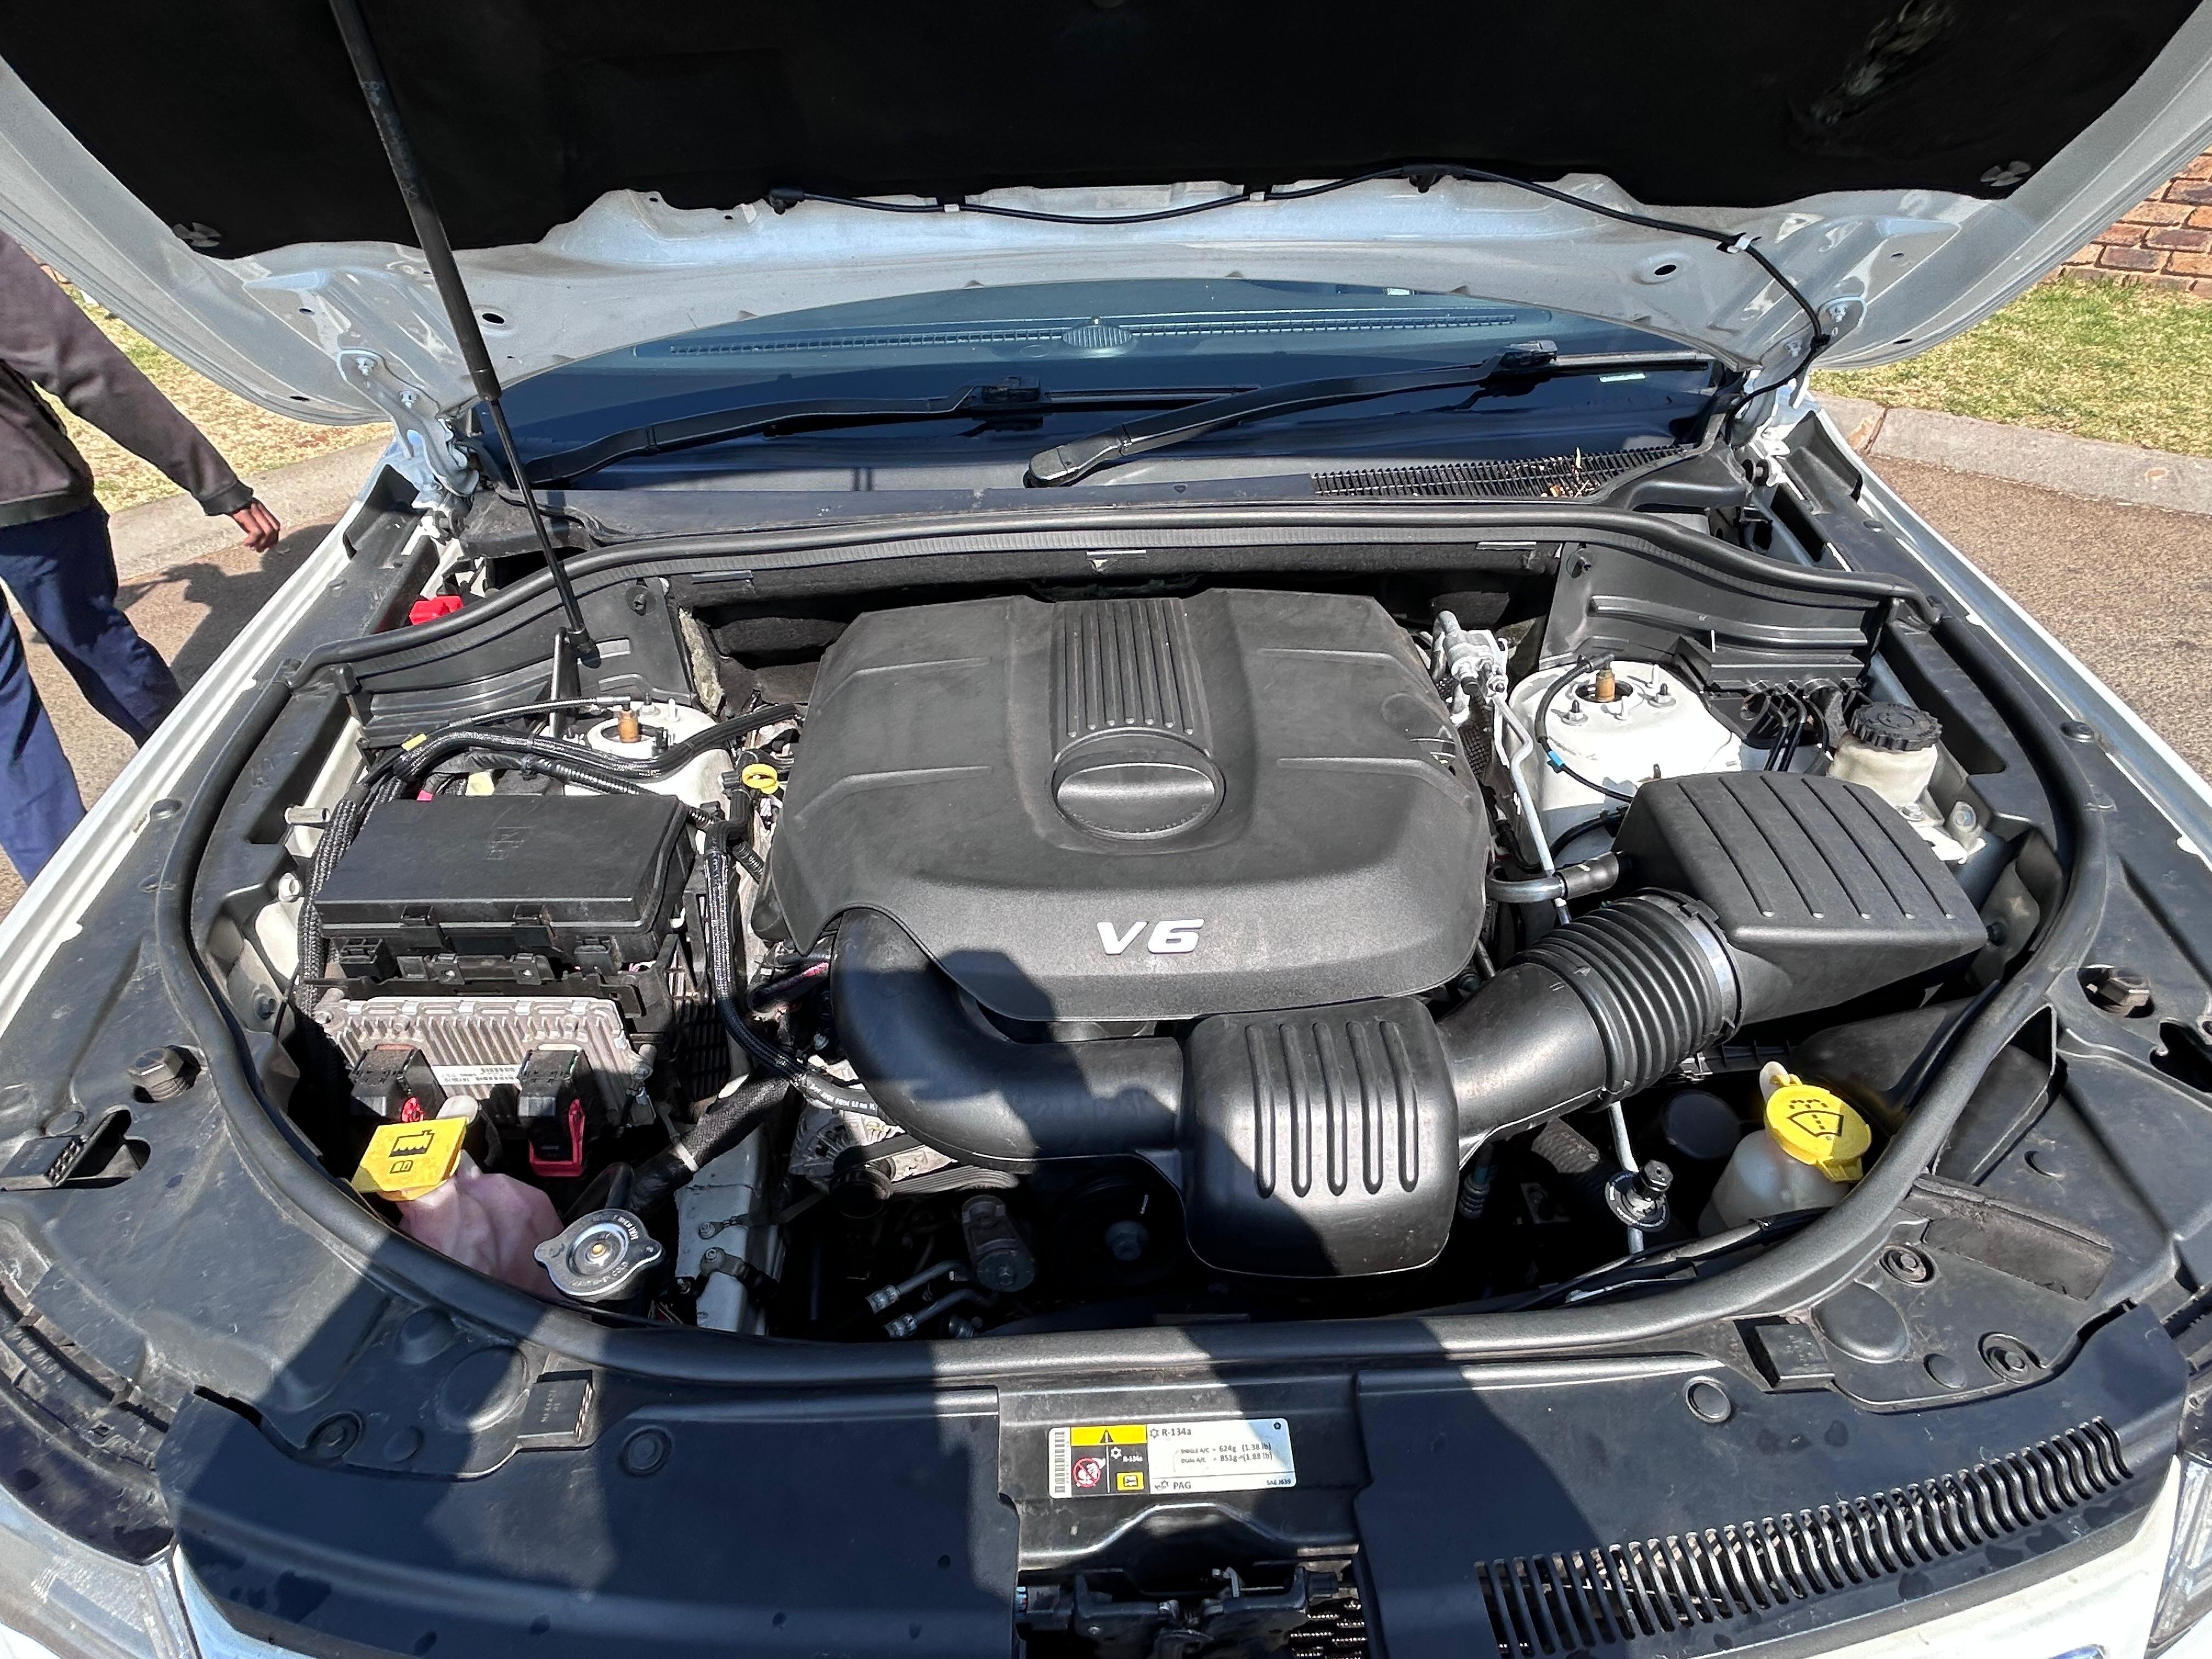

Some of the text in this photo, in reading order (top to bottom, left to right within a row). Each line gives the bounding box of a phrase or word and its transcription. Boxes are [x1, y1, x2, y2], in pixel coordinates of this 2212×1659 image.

[1096, 918, 1205, 955] V6
[1161, 1427, 1192, 1437] R-134a
[1261, 1442, 1272, 1451] lb)
[1262, 1452, 1273, 1460] lb)
[1173, 1481, 1192, 1489] PAG
